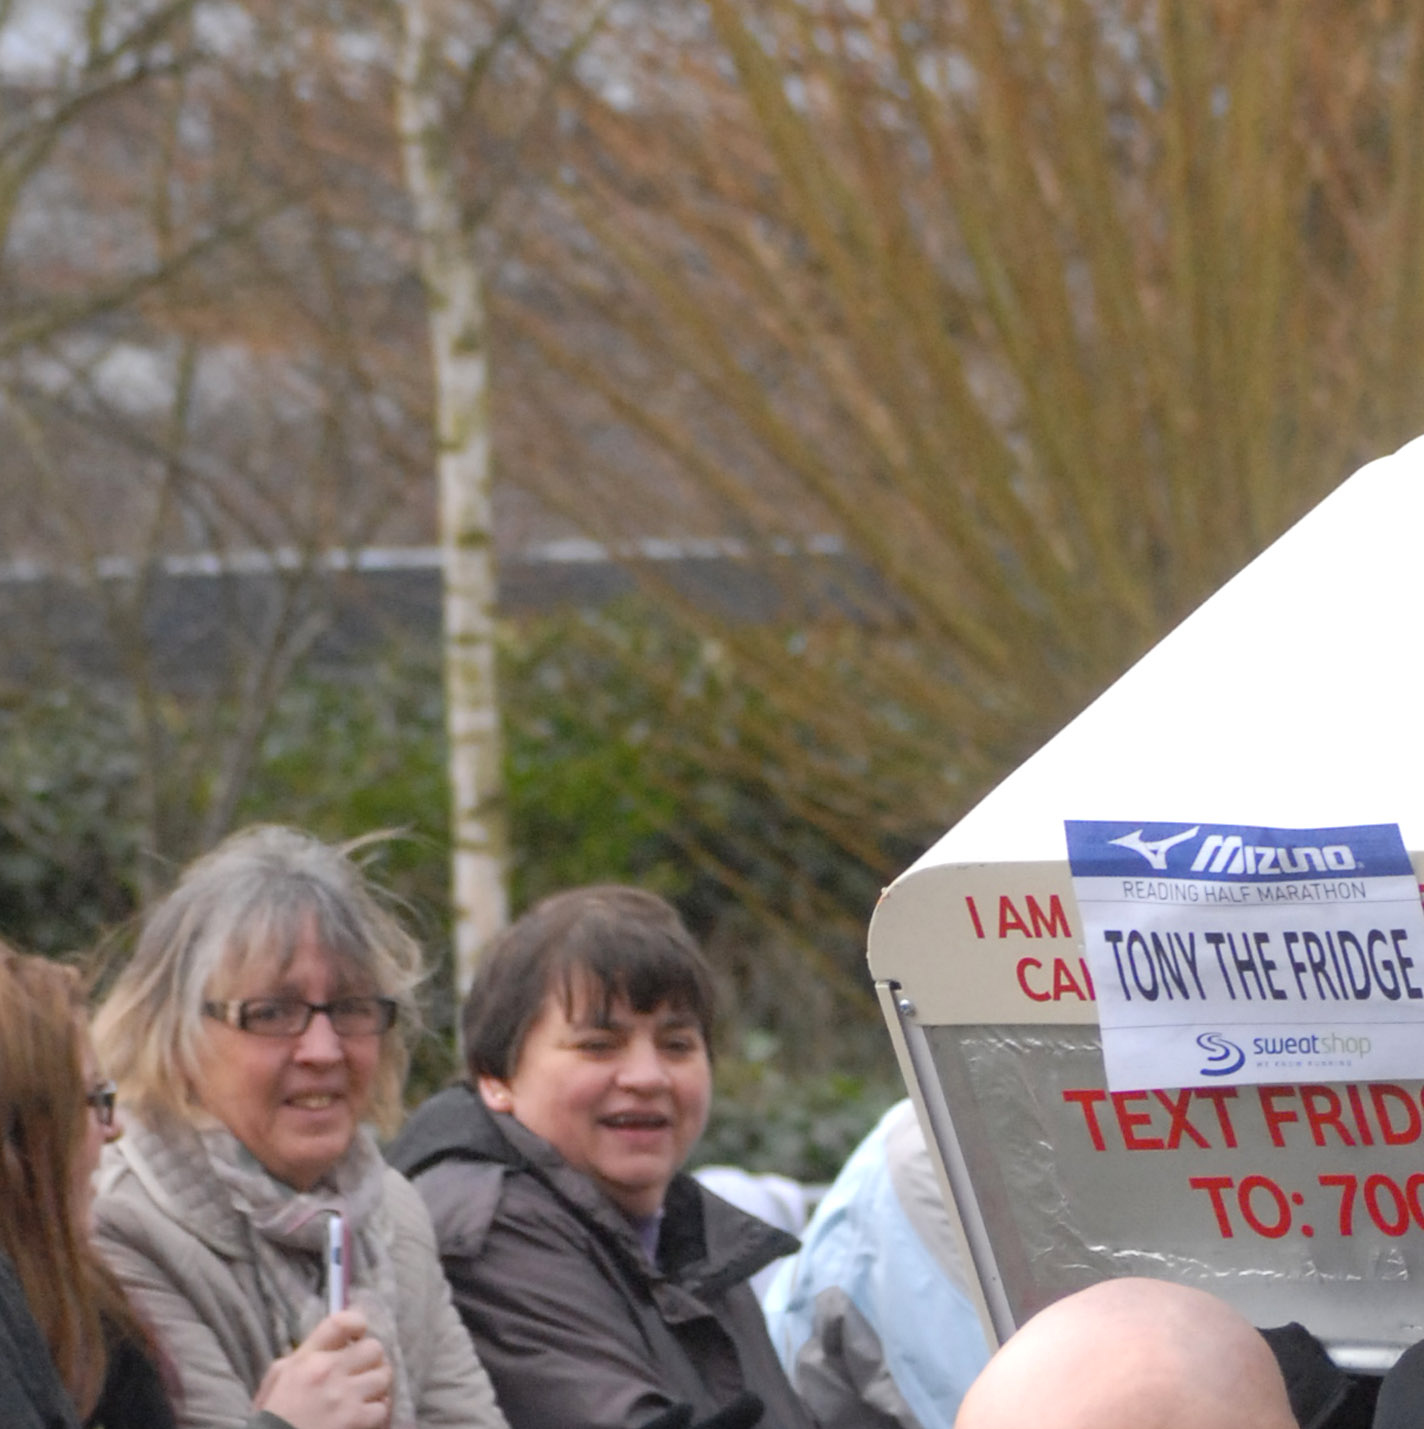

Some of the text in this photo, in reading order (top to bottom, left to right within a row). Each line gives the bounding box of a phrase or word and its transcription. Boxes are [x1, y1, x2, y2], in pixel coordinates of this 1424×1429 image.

[965, 892, 1073, 939] I AM
[1122, 880, 1368, 903] READING HALF MARATHON
[1104, 929, 1424, 1001] TONY THE FRIDGE
[1252, 1032, 1373, 1059] sweatshop
[1061, 1087, 1238, 1152] TEXT
[1188, 1173, 1315, 1239] TO:
